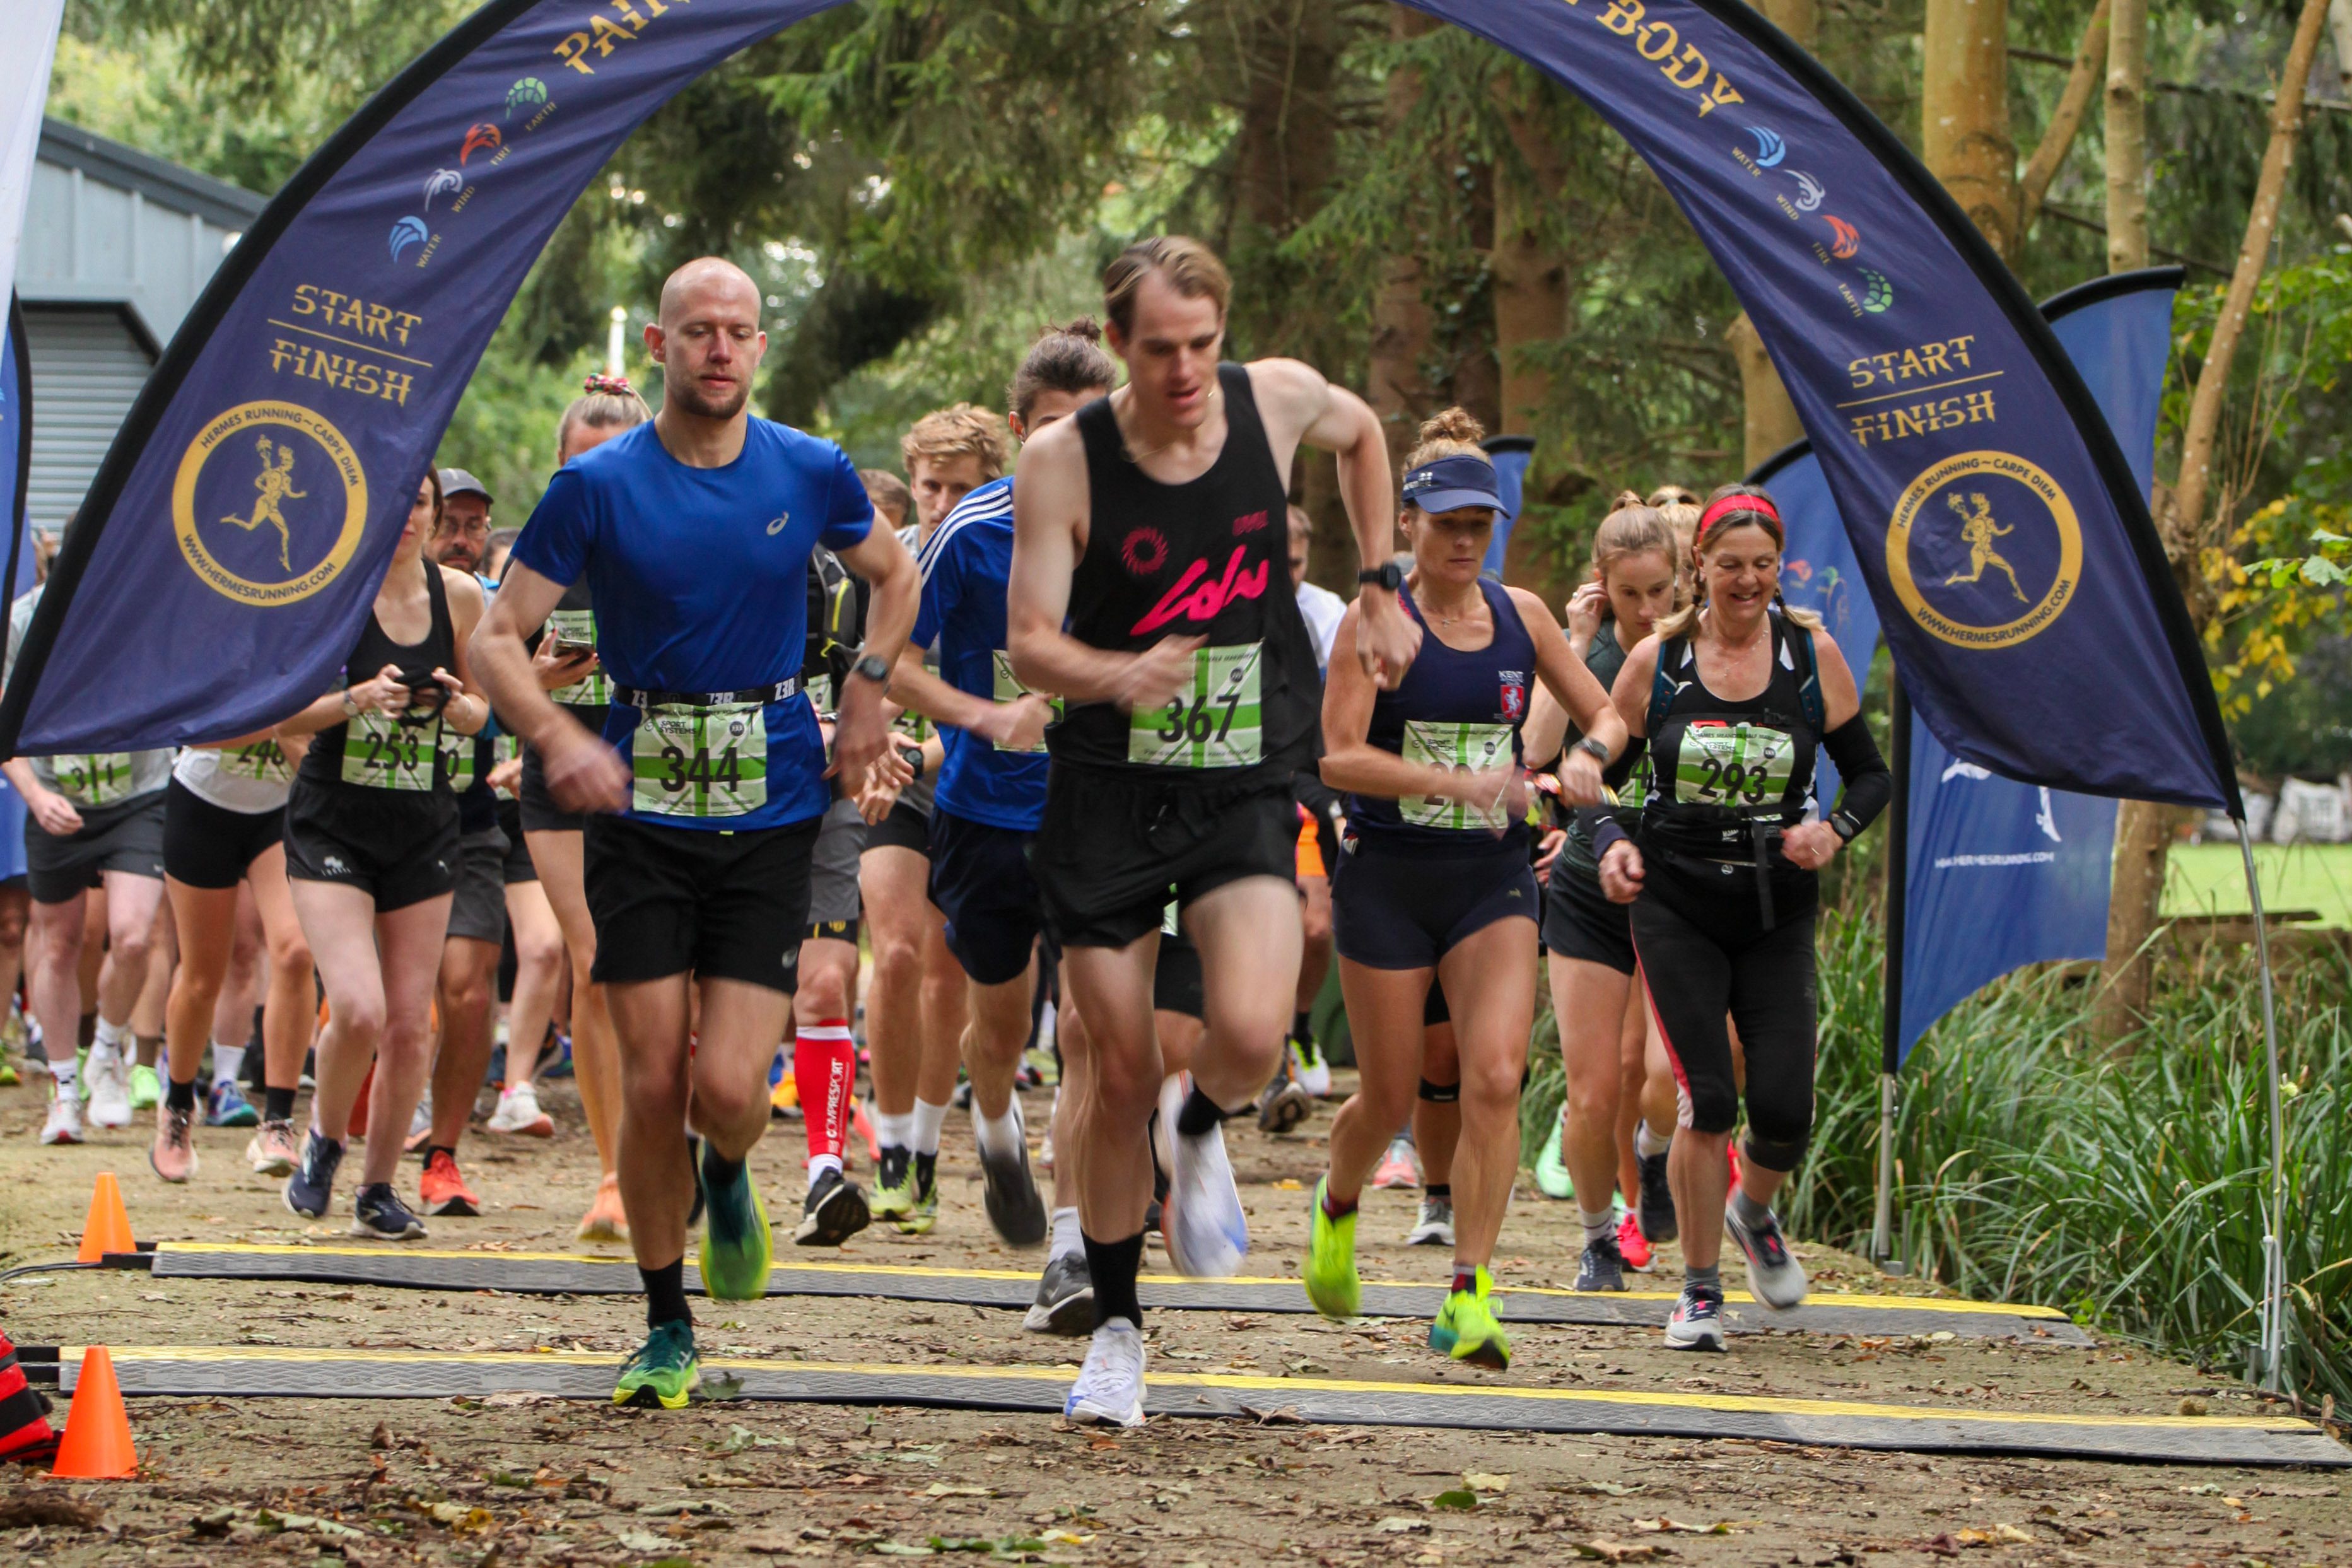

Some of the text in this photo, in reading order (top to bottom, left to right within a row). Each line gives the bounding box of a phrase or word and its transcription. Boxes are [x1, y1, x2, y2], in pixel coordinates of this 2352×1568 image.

[1595, 0, 1745, 117] BODY
[525, 101, 558, 131] EARTH
[489, 144, 512, 166] FIRE
[1732, 146, 1762, 178] WATER
[451, 186, 475, 213] WIND
[1776, 194, 1799, 221] WIND
[416, 233, 442, 269] WATER
[1811, 242, 1832, 266] FIRE
[292, 284, 423, 346] START
[1839, 283, 1863, 317] EARTH
[269, 339, 414, 407] FINISH
[1849, 335, 1975, 389] START
[1851, 390, 1996, 448] FINISH
[201, 414, 242, 449] HERMES
[245, 408, 302, 423] RUNNING
[313, 423, 344, 455] CARPE
[341, 456, 360, 487] DIEM
[1897, 486, 1926, 528] HERMES
[1925, 458, 1980, 487] RUNNING
[1993, 459, 2030, 478] CARPE
[2030, 474, 2056, 501] DIEM
[183, 534, 336, 600] WWW.HERMESRUNNING.COM
[1917, 579, 2071, 642] WWW.HERMESRUNNING.COM
[1158, 693, 1241, 743] 367
[364, 732, 419, 771] 253
[660, 746, 741, 793] 344
[1698, 758, 1768, 804] 293
